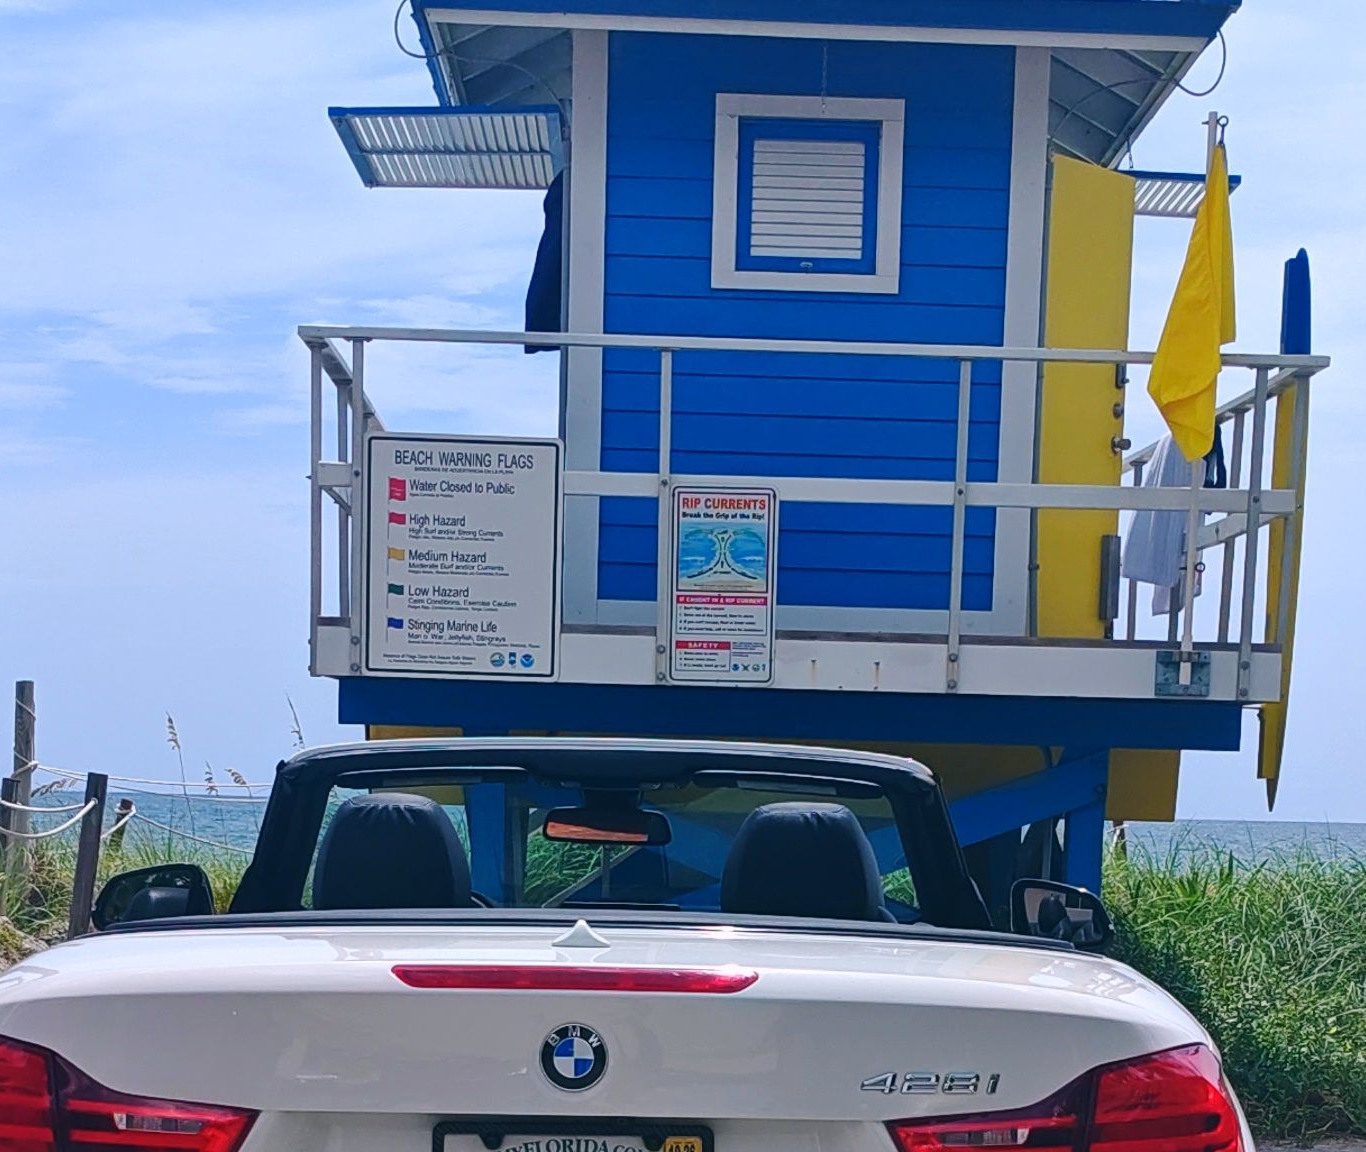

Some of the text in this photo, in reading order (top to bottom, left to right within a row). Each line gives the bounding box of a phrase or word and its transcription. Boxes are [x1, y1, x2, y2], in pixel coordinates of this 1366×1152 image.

[394, 450, 534, 469] BEACH WARNING FLAGS
[409, 479, 437, 492] Water
[440, 480, 472, 494] Closed
[475, 482, 484, 493] to
[487, 482, 515, 495] Public
[682, 498, 766, 510] RIP CURRENTS
[409, 513, 465, 528] High Hazard
[715, 512, 729, 520] Grip
[409, 549, 487, 563] Medium Hazard
[408, 585, 469, 598] Low Hazard
[408, 618, 497, 633] Stinging Marine Life
[547, 1025, 602, 1048] BMW
[860, 1072, 1000, 1095] 428i
